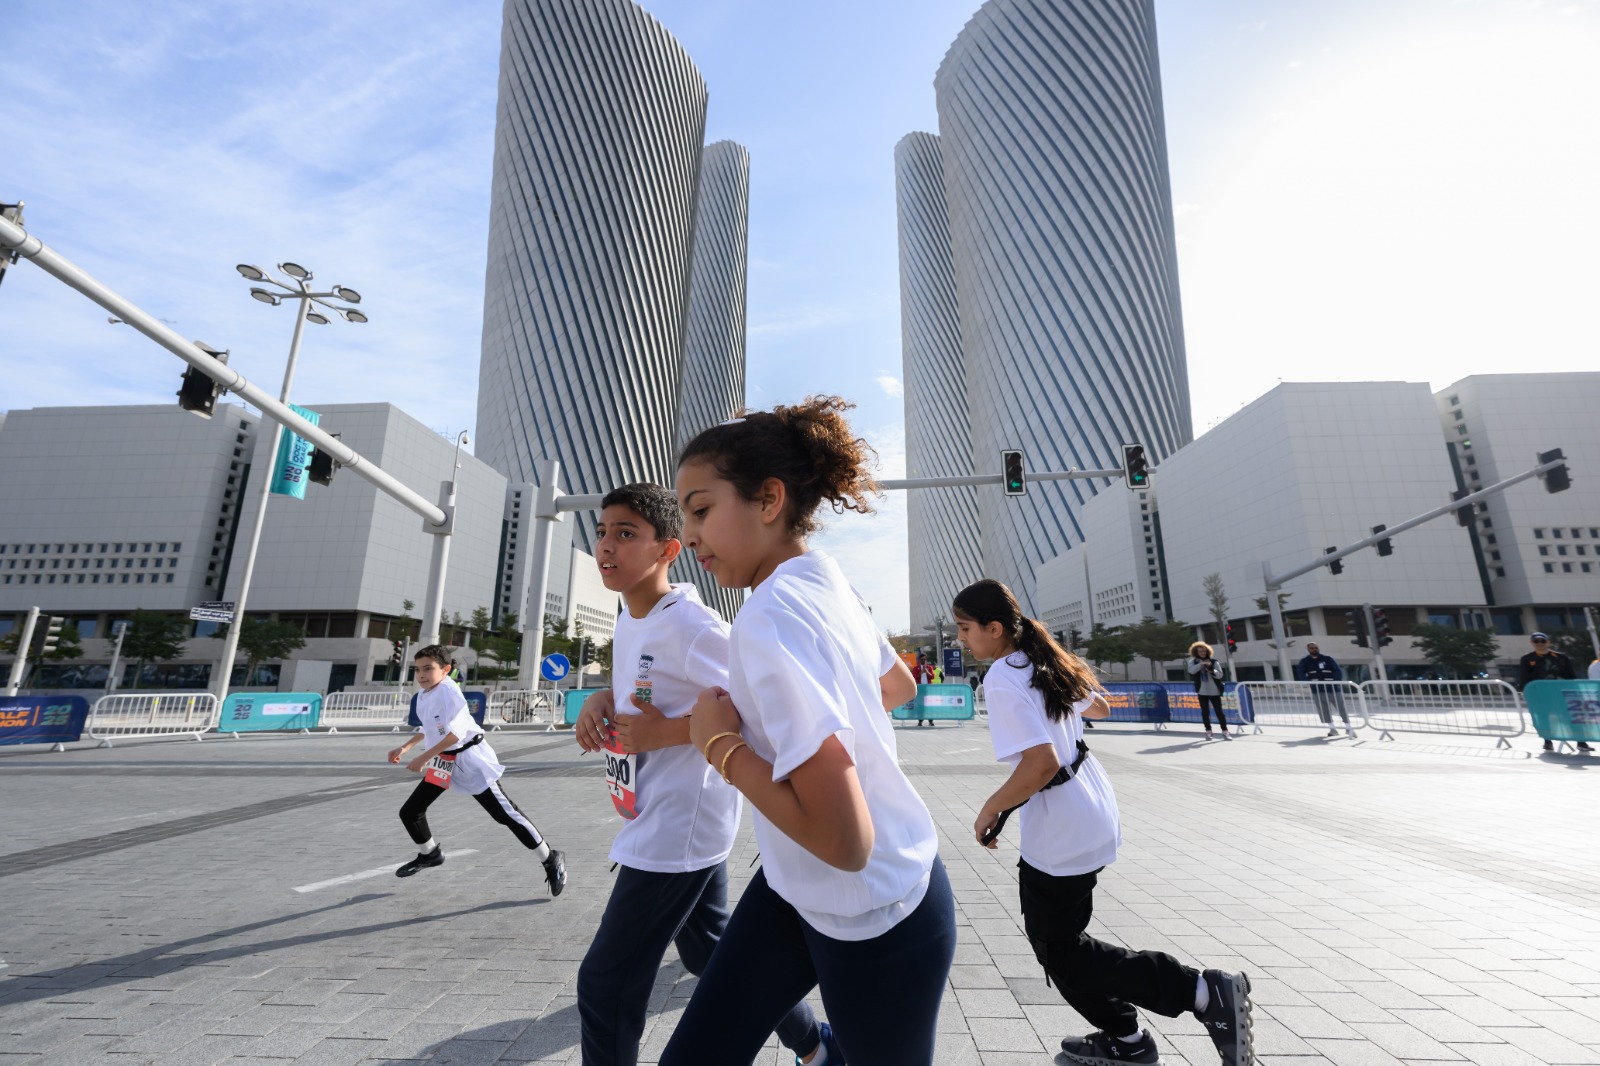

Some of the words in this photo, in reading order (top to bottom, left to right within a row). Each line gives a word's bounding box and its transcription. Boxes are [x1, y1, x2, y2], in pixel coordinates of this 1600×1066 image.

[293, 445, 301, 462] QOC
[285, 465, 302, 475] 20
[283, 474, 301, 482] 25
[636, 688, 652, 696] 20
[43, 705, 72, 715] 20
[234, 704, 253, 712] 20
[40, 716, 69, 725] 25
